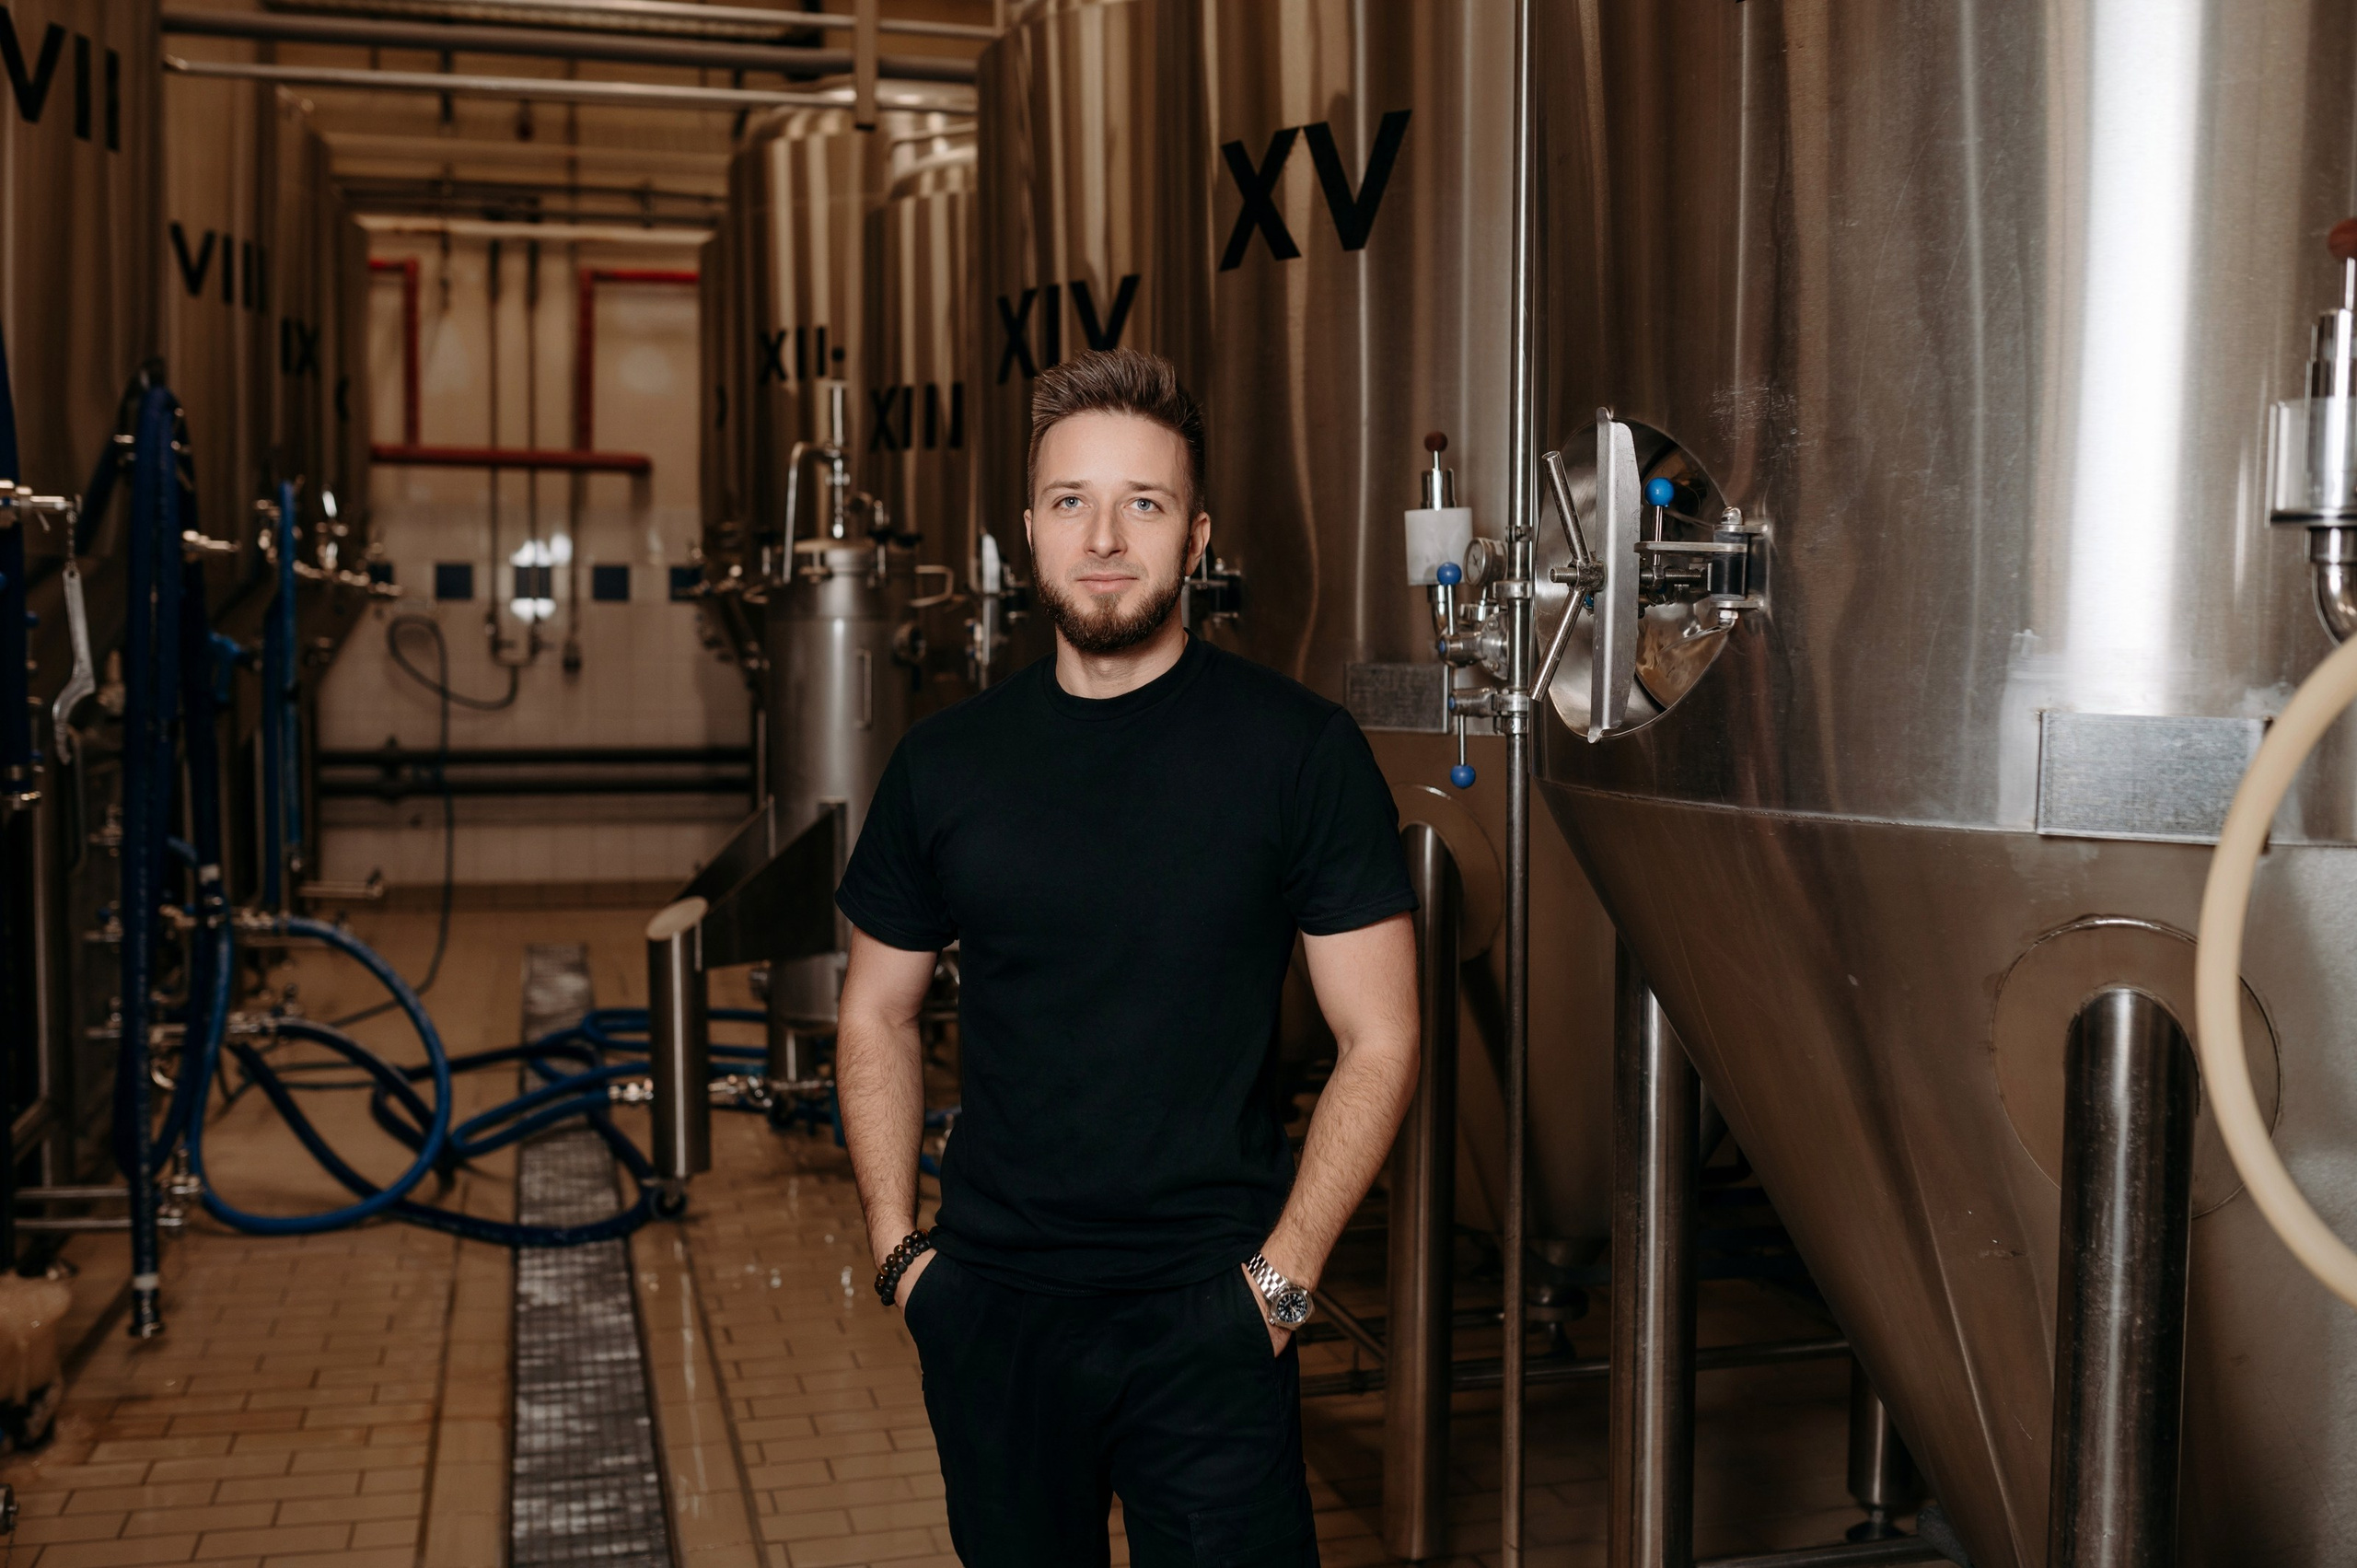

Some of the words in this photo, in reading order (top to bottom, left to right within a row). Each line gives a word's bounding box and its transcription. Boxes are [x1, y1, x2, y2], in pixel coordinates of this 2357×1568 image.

[0, 5, 120, 152] VII
[1219, 109, 1412, 273] XV
[169, 223, 265, 312] VIII
[281, 317, 319, 380] IX
[997, 274, 1141, 385] XIV
[870, 381, 963, 452] XIII
